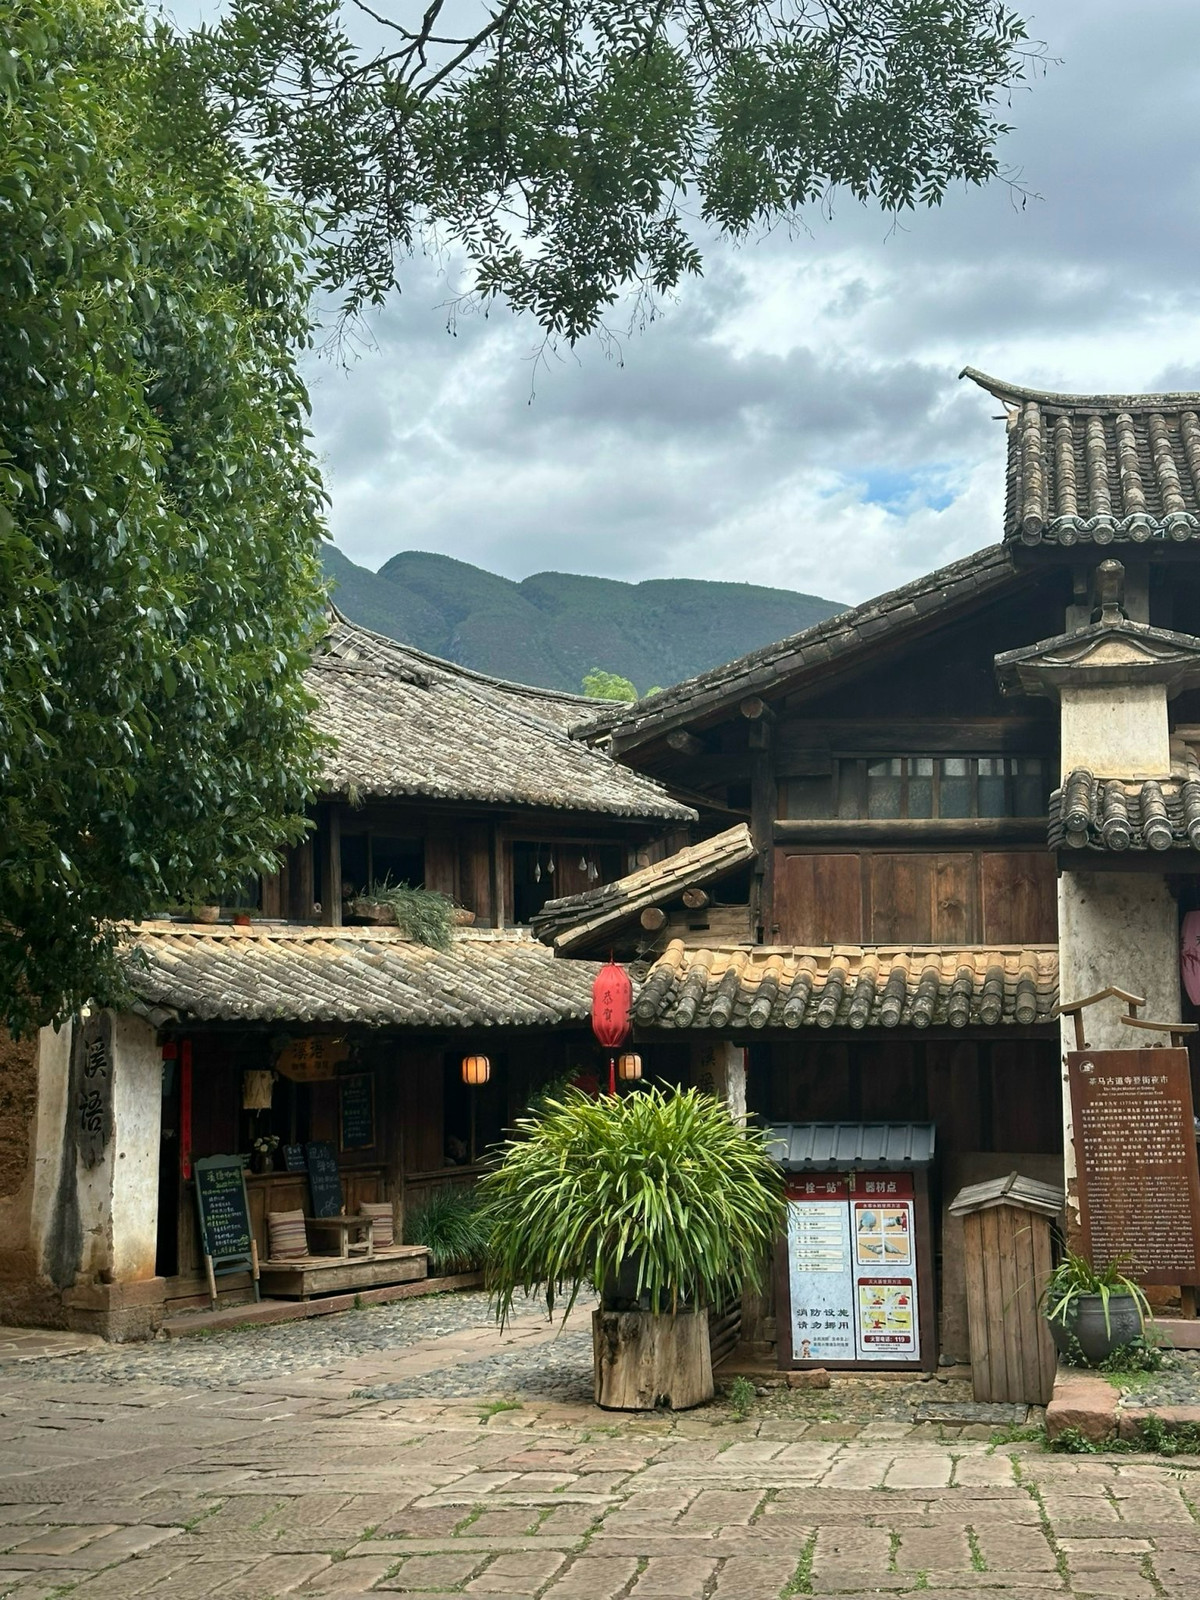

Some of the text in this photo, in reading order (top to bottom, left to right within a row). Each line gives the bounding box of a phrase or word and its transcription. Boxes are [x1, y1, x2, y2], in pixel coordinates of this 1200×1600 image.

[866, 1182, 896, 1192] 器材点
[796, 1308, 850, 1317] 消防设施
[797, 1322, 849, 1330] 请勿挪用
